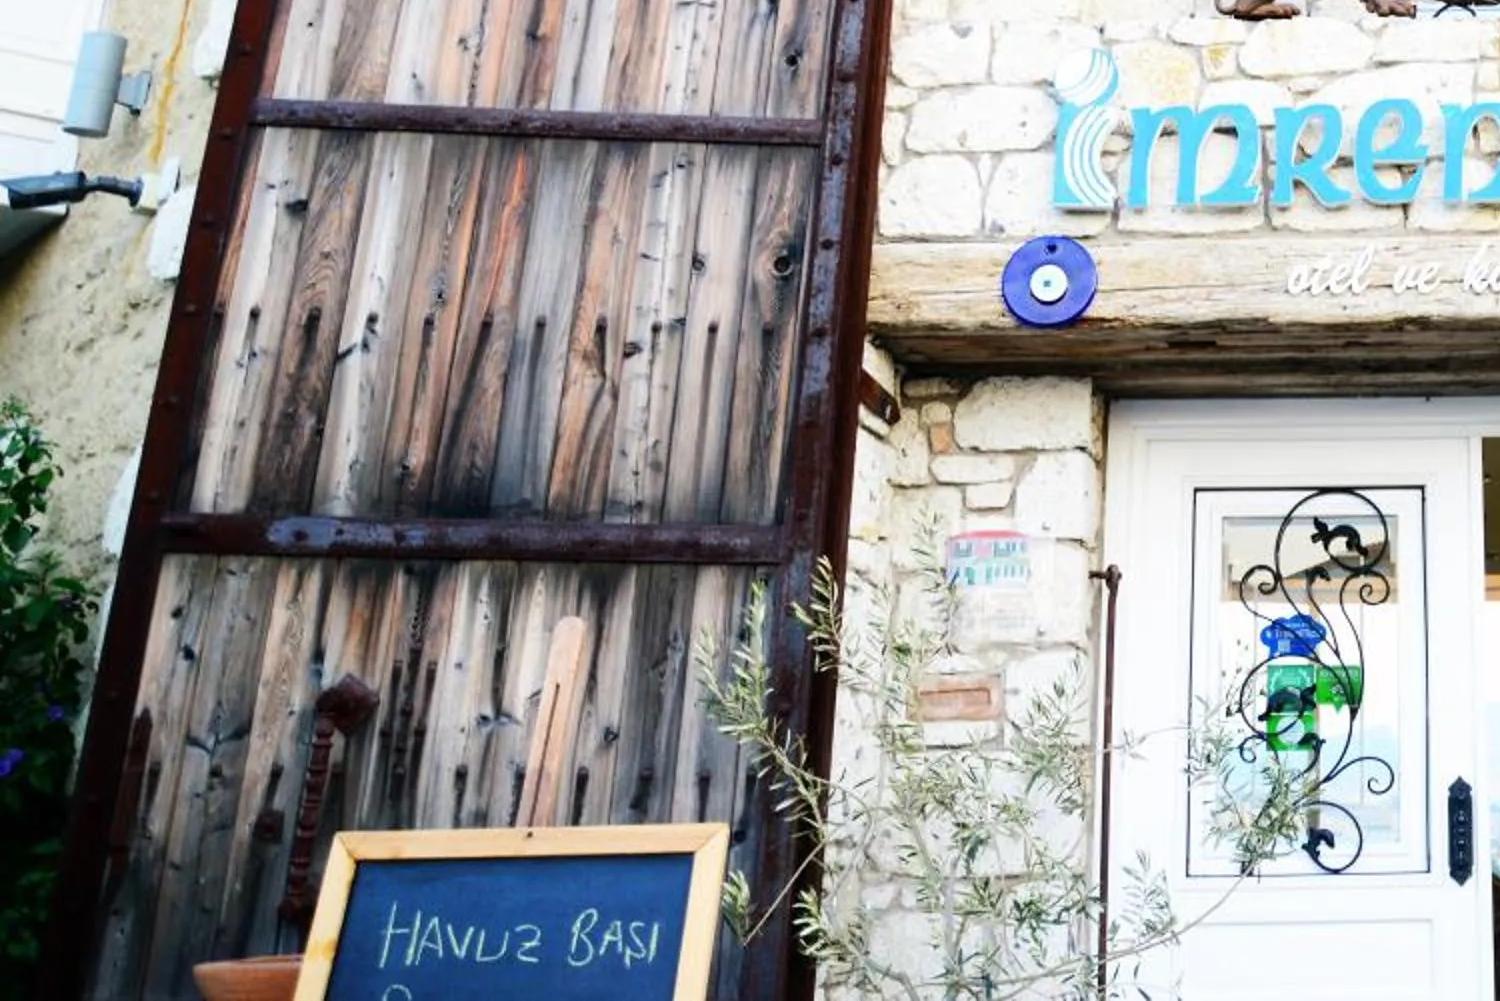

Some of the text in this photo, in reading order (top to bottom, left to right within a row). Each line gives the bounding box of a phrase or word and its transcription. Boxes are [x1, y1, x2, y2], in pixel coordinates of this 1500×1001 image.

[1286, 244, 1373, 296] otel
[1393, 259, 1440, 295] ve
[378, 901, 541, 968] HAVUZ
